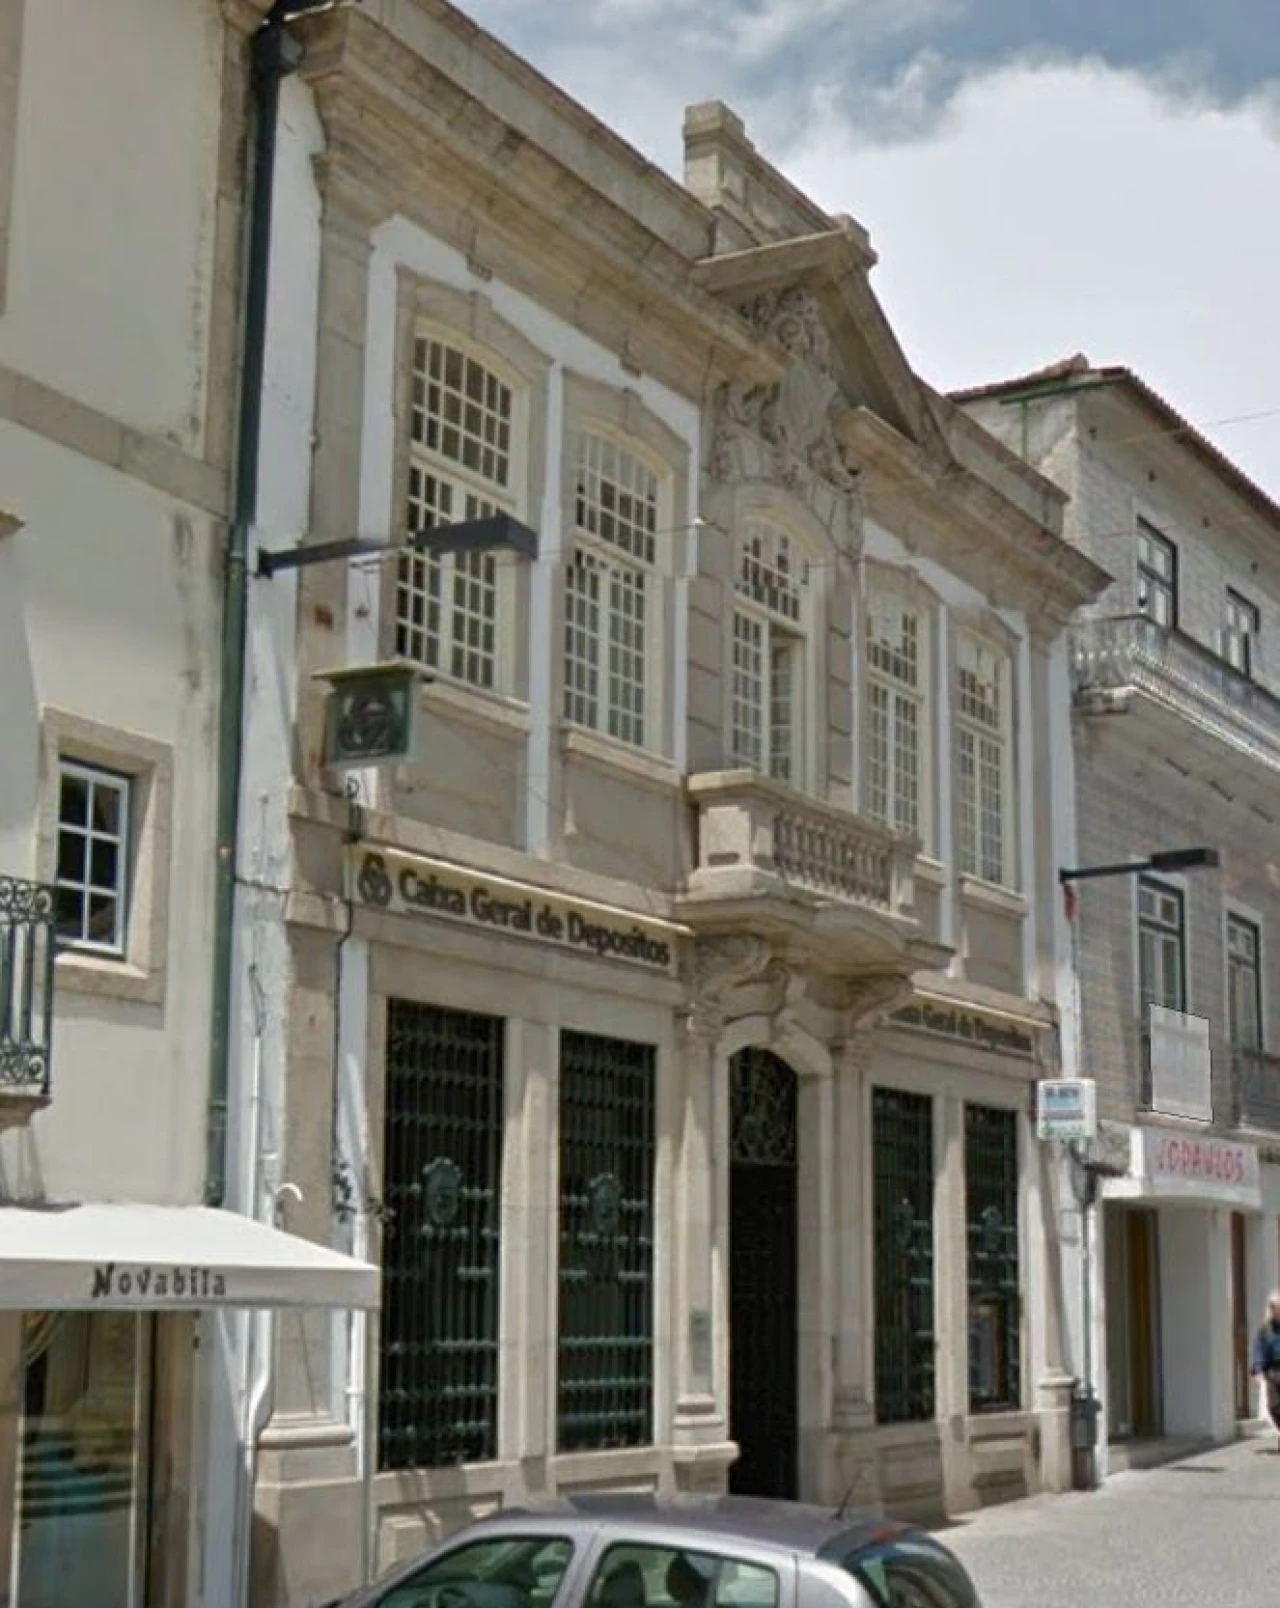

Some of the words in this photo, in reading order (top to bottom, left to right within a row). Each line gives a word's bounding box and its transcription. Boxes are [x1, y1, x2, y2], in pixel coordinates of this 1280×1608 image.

[399, 868, 466, 915] Caixa
[470, 887, 533, 932] Geral
[536, 904, 564, 940] de
[92, 1261, 226, 1298] Novabila
